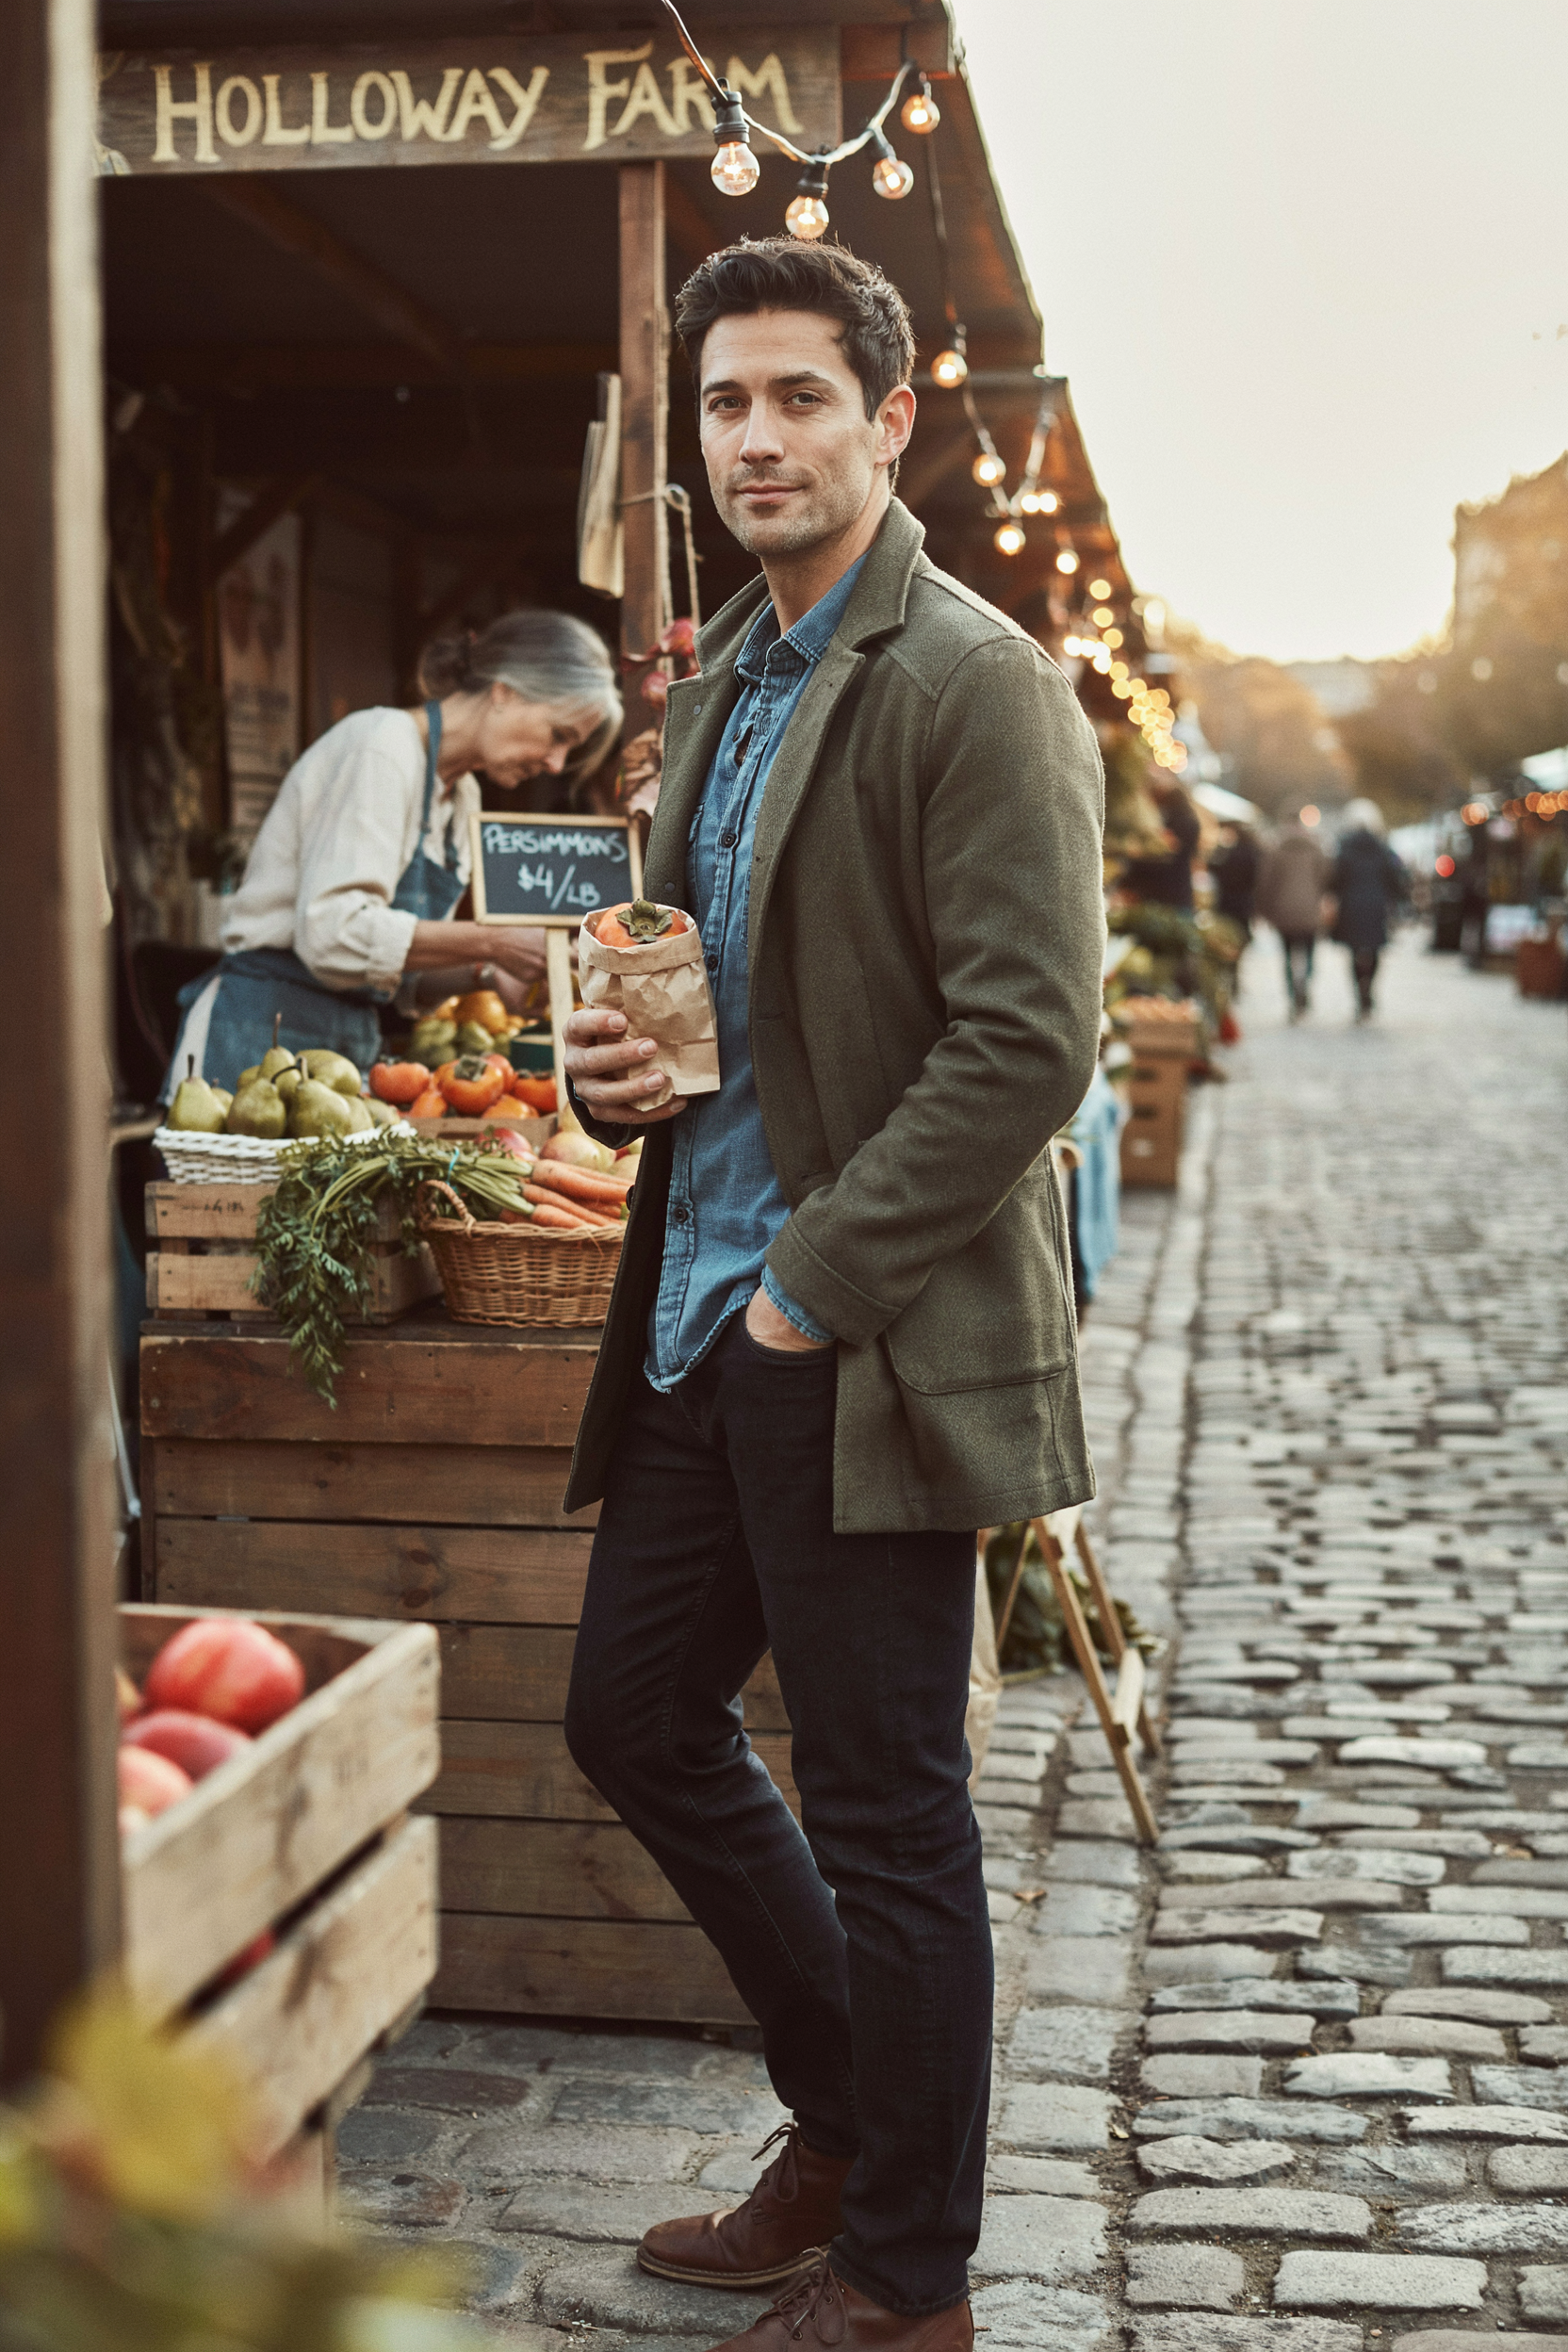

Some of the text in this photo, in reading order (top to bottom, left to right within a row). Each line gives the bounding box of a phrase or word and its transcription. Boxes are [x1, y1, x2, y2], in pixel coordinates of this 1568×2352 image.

[150, 41, 804, 162] HOLLOWAY FARM
[517, 862, 600, 910] $4/LB
